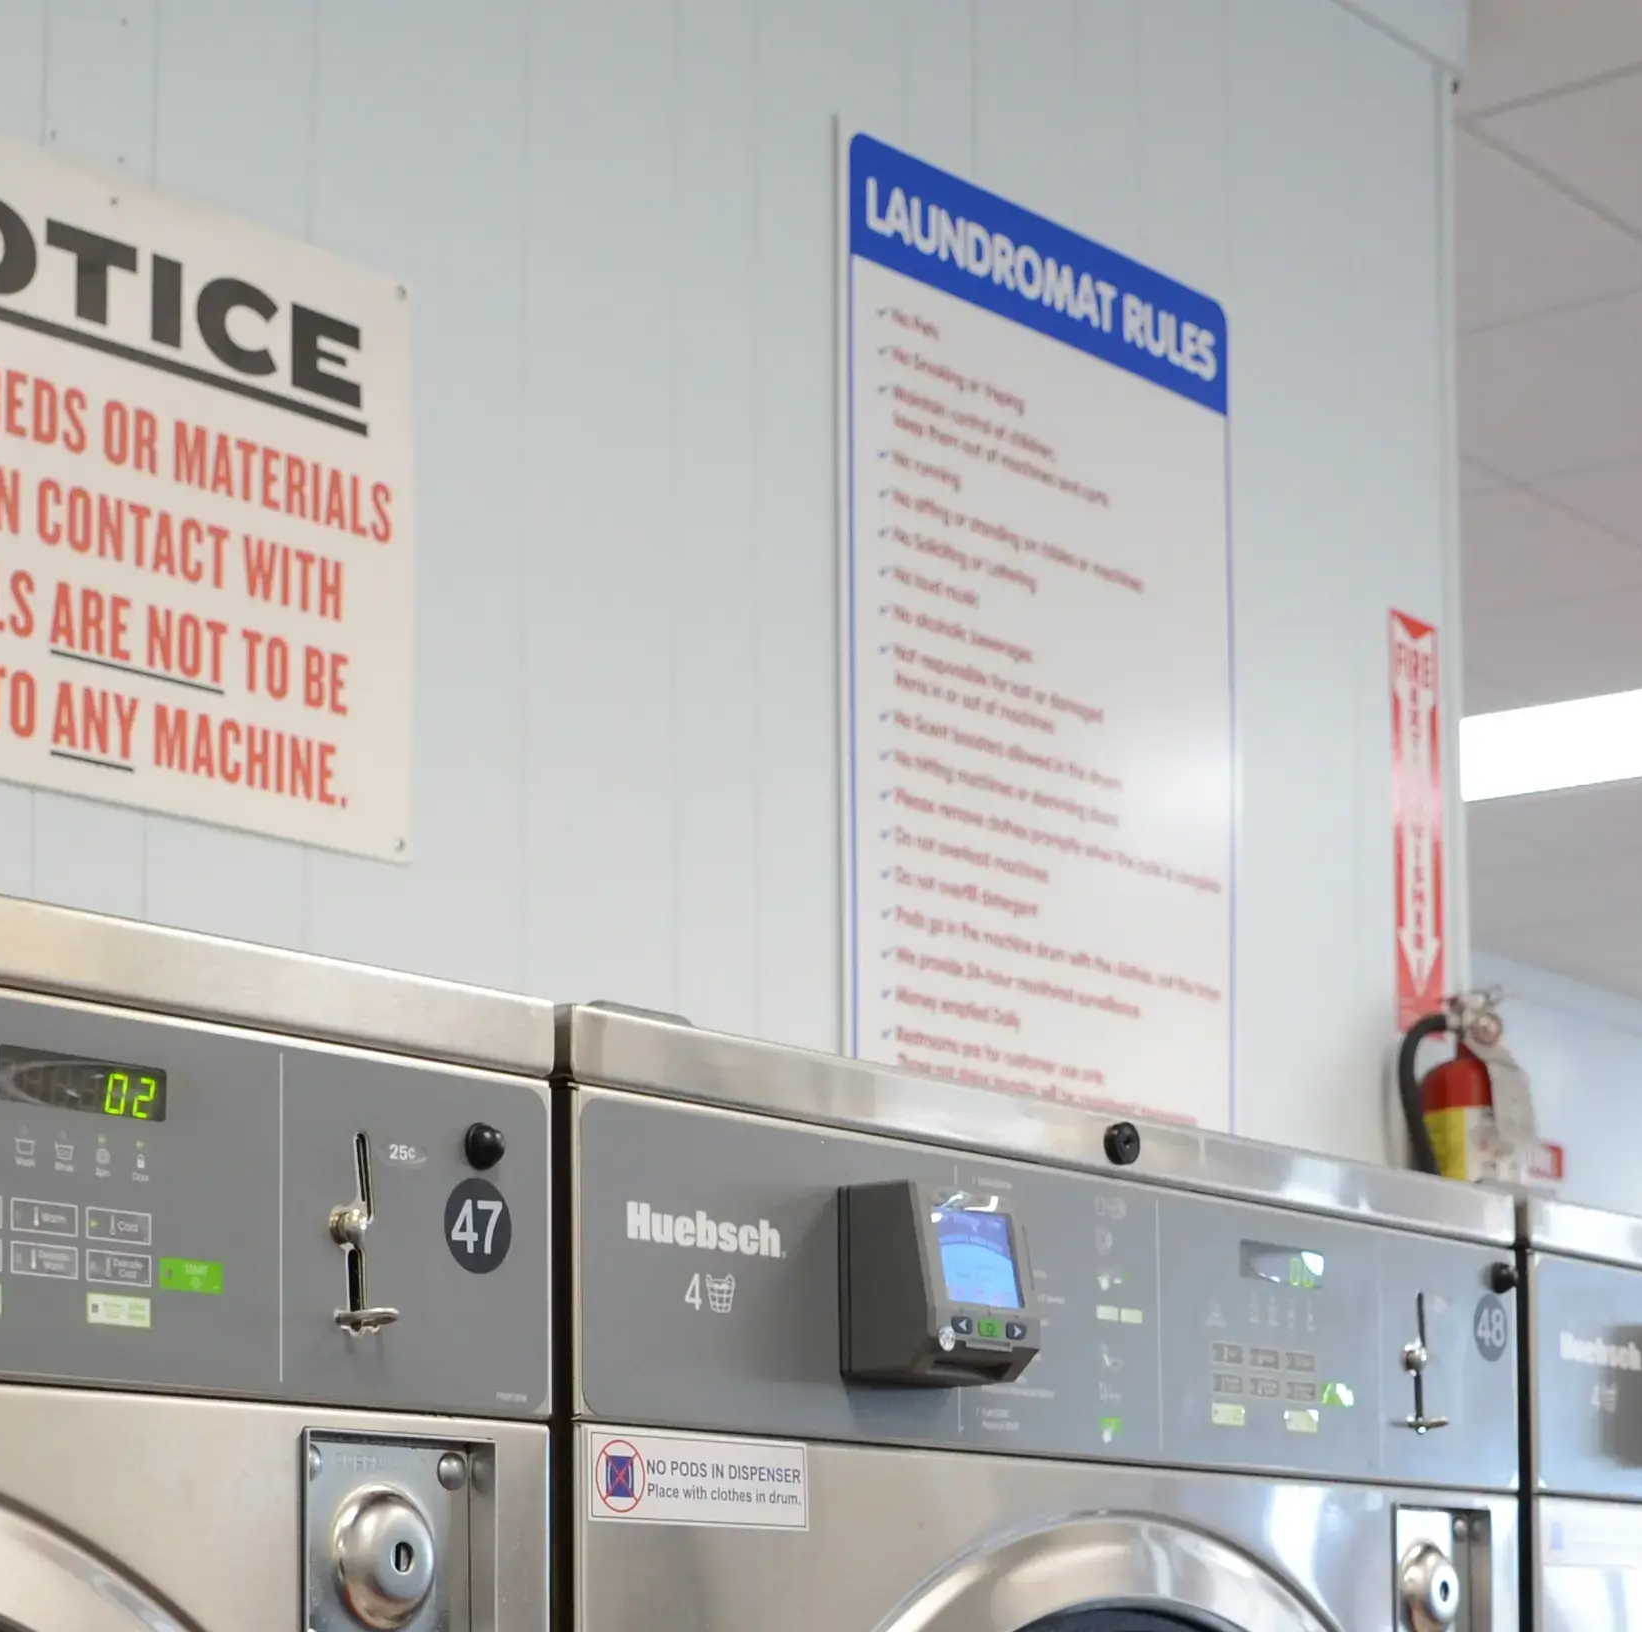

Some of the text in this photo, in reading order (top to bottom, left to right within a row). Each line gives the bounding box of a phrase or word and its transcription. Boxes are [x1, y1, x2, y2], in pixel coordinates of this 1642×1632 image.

[866, 177, 1216, 381] LAUNDROMAT RULES
[103, 400, 157, 475] OR
[174, 421, 391, 543] MATERIALS
[37, 479, 228, 589] CONTACT
[243, 535, 343, 621] WITH
[50, 581, 129, 661] ARE
[148, 606, 226, 683] NOT
[242, 630, 286, 699] TO
[305, 646, 347, 715] BE
[52, 681, 139, 759] ANY
[154, 704, 348, 807] MACHINE.
[104, 1073, 157, 1119] 02
[389, 1143, 416, 1160] 25¢
[117, 1220, 139, 1233] Cold
[451, 1199, 503, 1254] 47
[626, 1200, 781, 1258] Huebsch
[684, 1273, 702, 1311] 4
[1476, 1307, 1507, 1344] 48
[646, 1459, 801, 1485] NO PODS IN DISPENSER
[647, 1483, 802, 1506] Place with clothes in drum.
